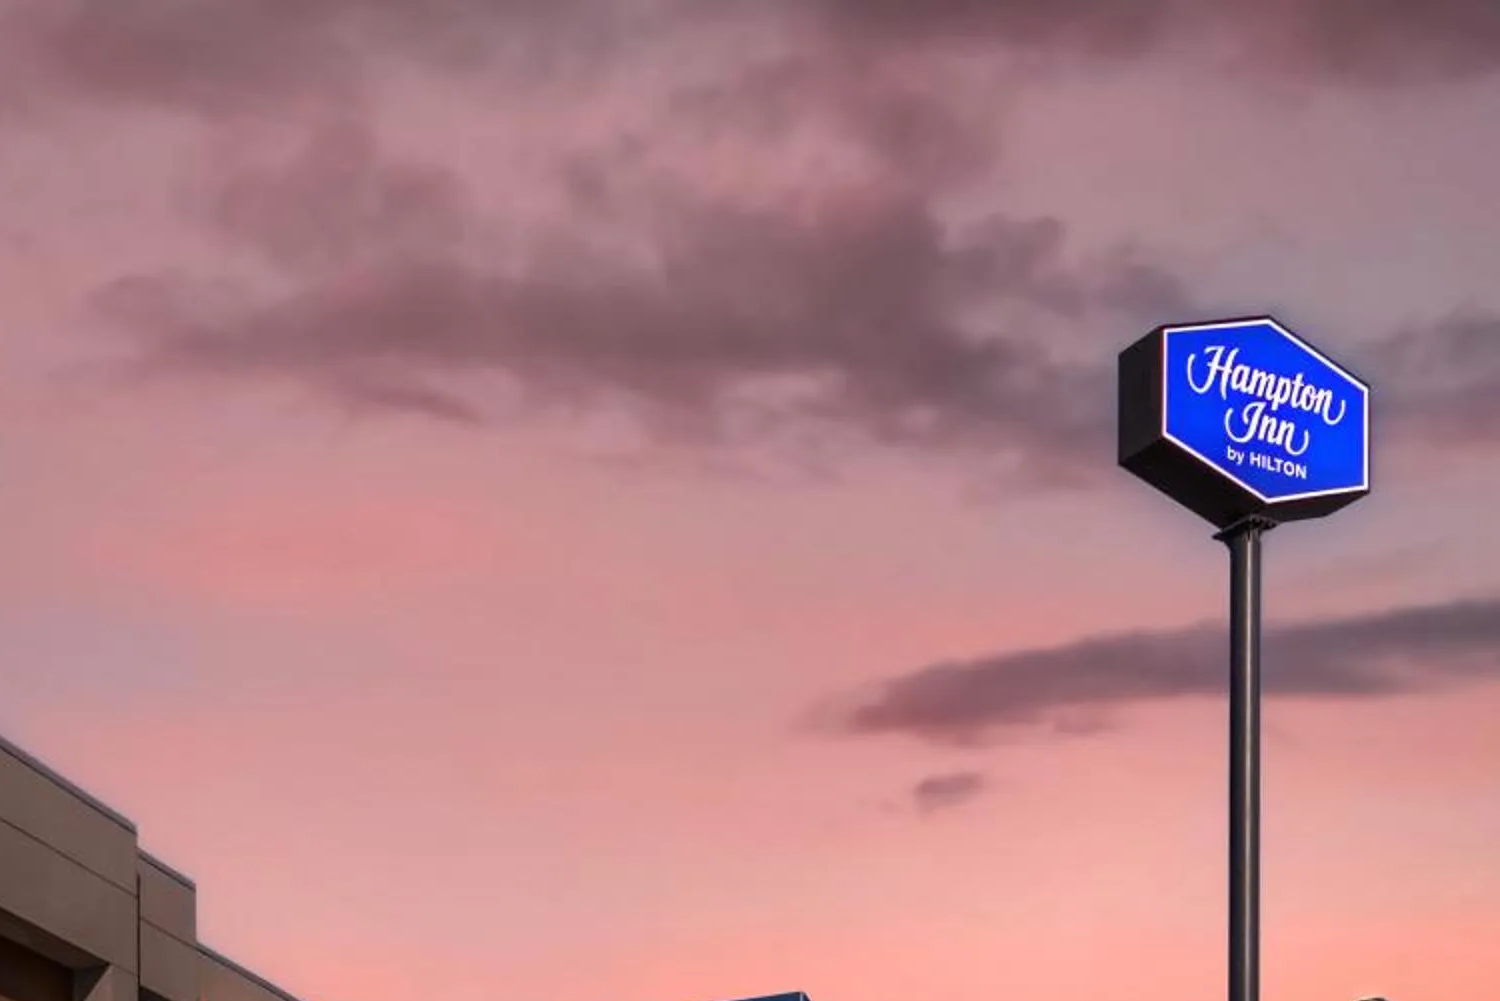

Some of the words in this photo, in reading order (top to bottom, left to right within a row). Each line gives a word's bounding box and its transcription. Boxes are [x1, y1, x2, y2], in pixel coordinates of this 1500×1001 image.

[1187, 346, 1346, 426] Hampton
[1224, 402, 1309, 456] Inn
[1227, 445, 1245, 466] by
[1249, 451, 1307, 480] HILTON
